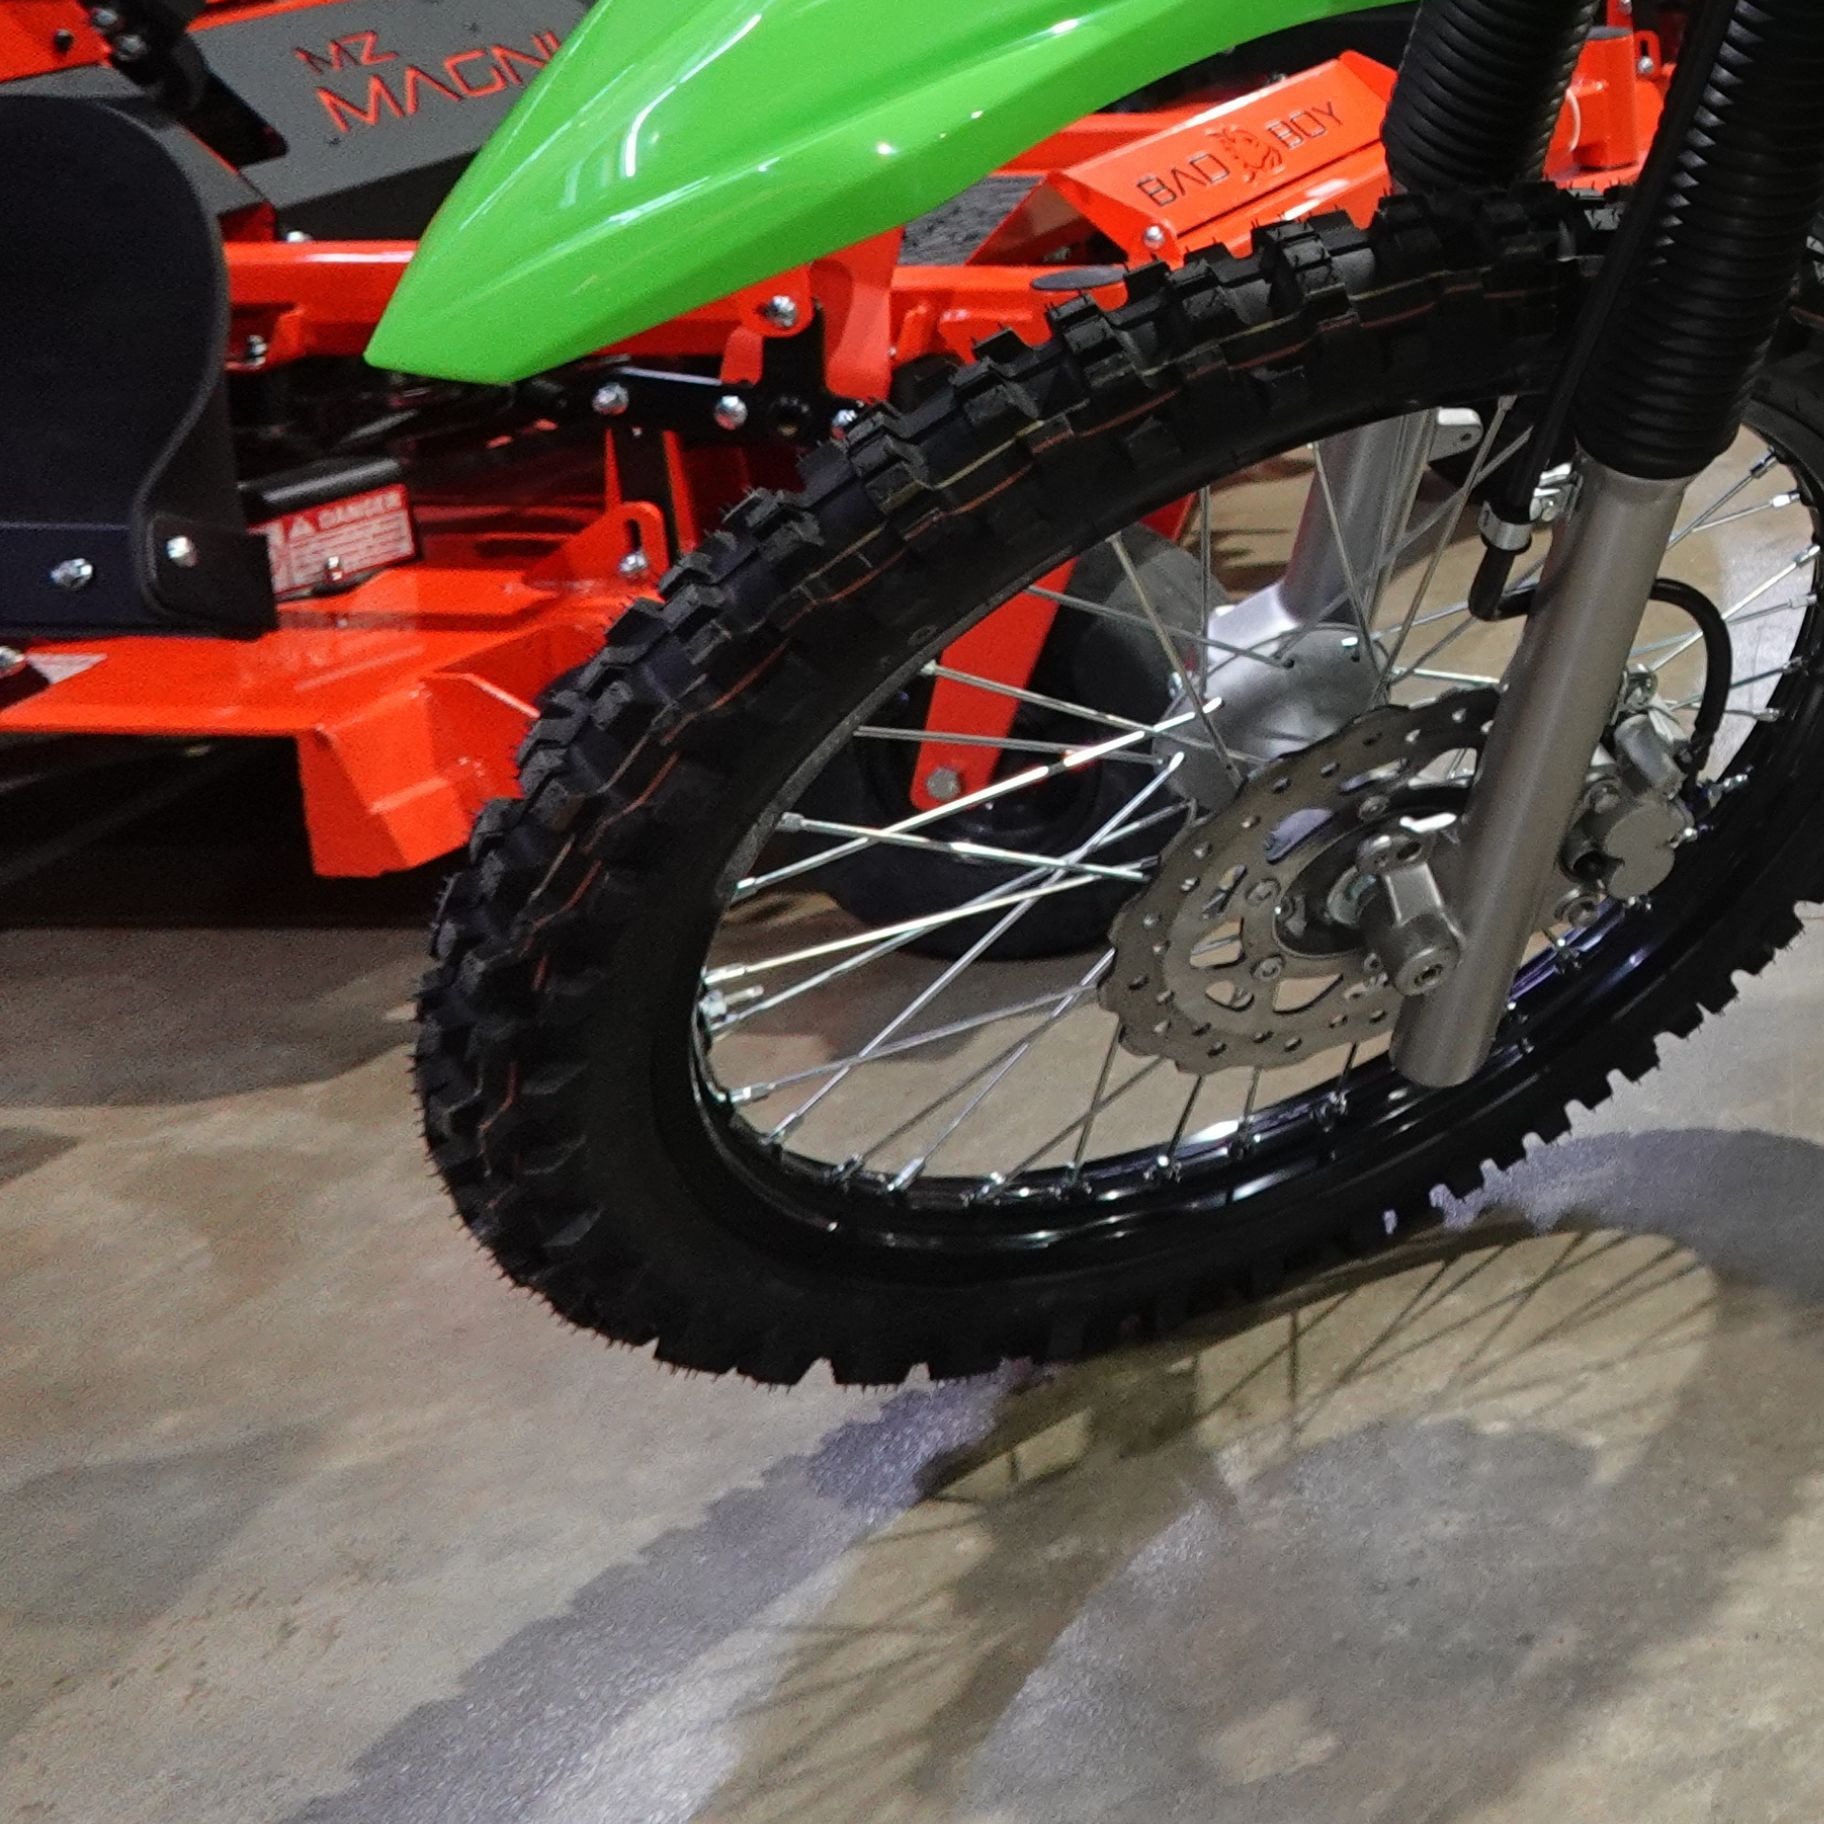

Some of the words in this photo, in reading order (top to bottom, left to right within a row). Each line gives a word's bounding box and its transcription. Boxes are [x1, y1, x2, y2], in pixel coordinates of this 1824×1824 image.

[294, 30, 400, 75] MZ
[1136, 152, 1231, 207] BAD
[1266, 100, 1344, 150] BOY
